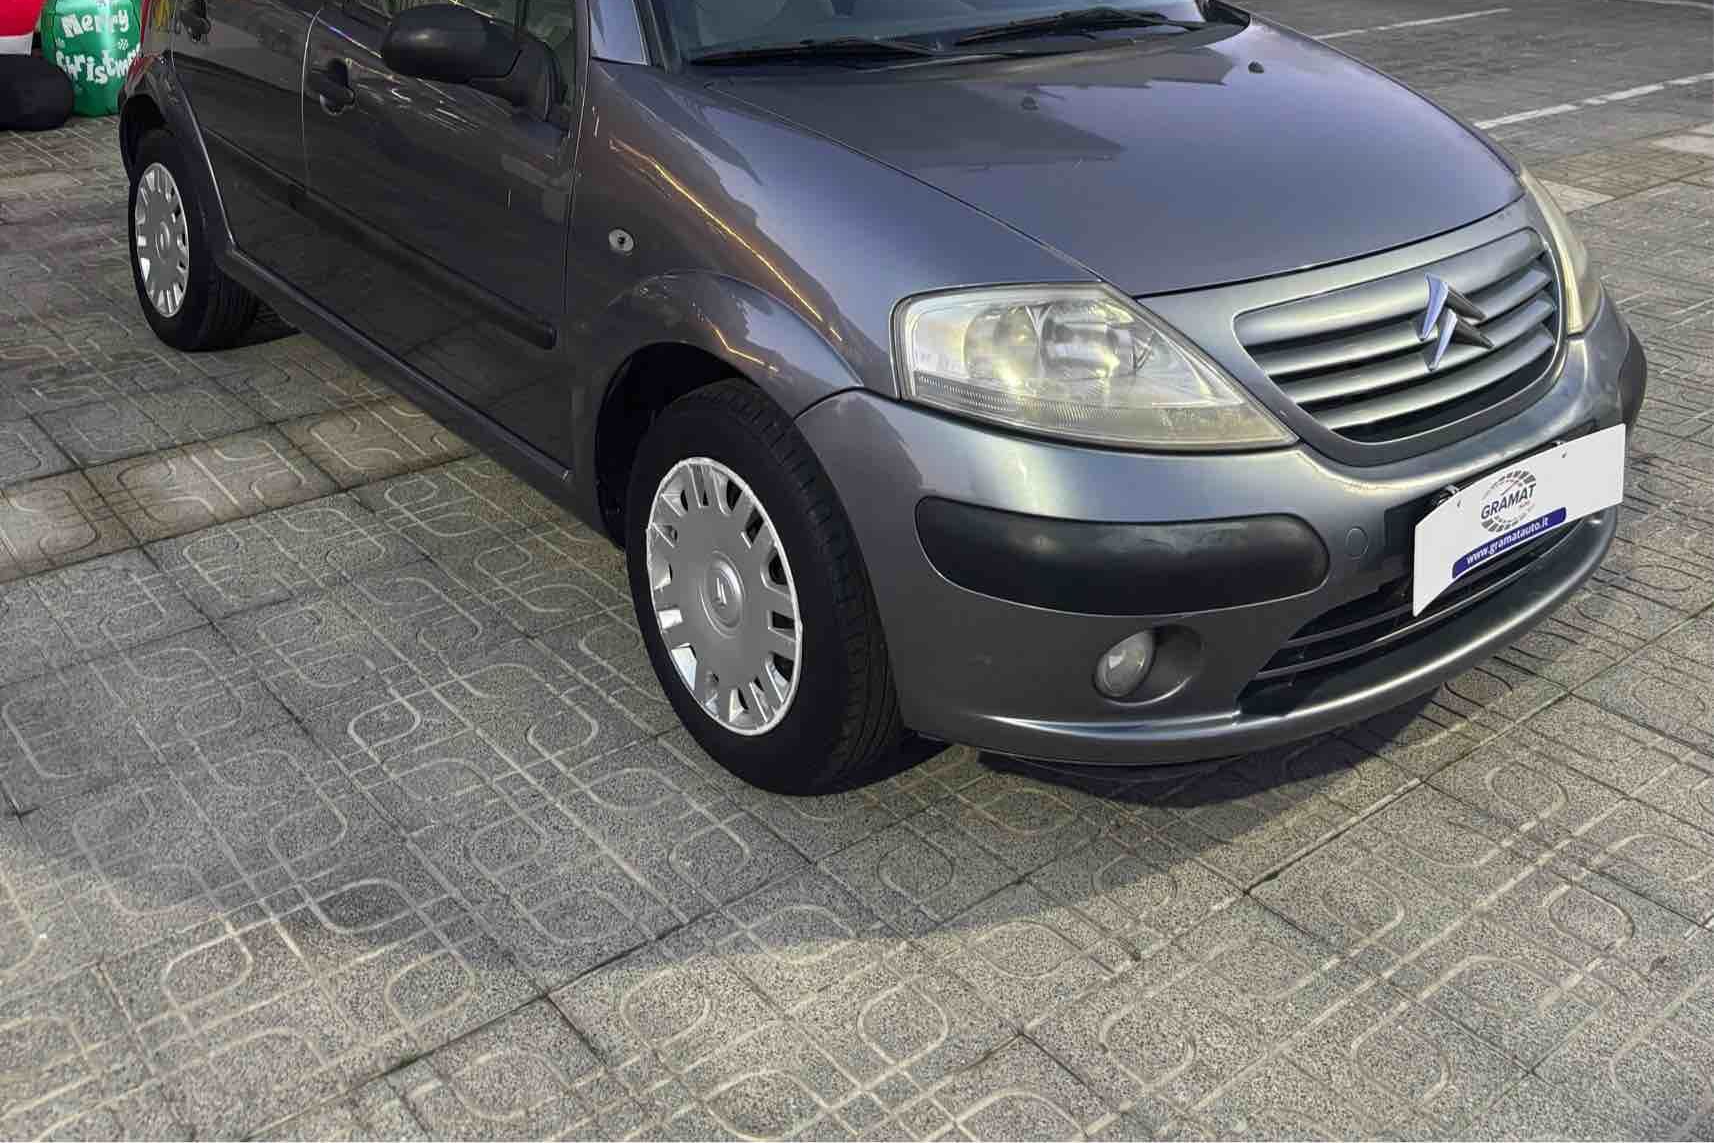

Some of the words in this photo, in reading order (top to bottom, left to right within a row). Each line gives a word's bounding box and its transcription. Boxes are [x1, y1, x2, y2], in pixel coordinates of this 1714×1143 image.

[62, 10, 129, 37] Merry
[1481, 483, 1536, 519] GRAMAT
[1467, 517, 1549, 564] www.gramatauto.it
